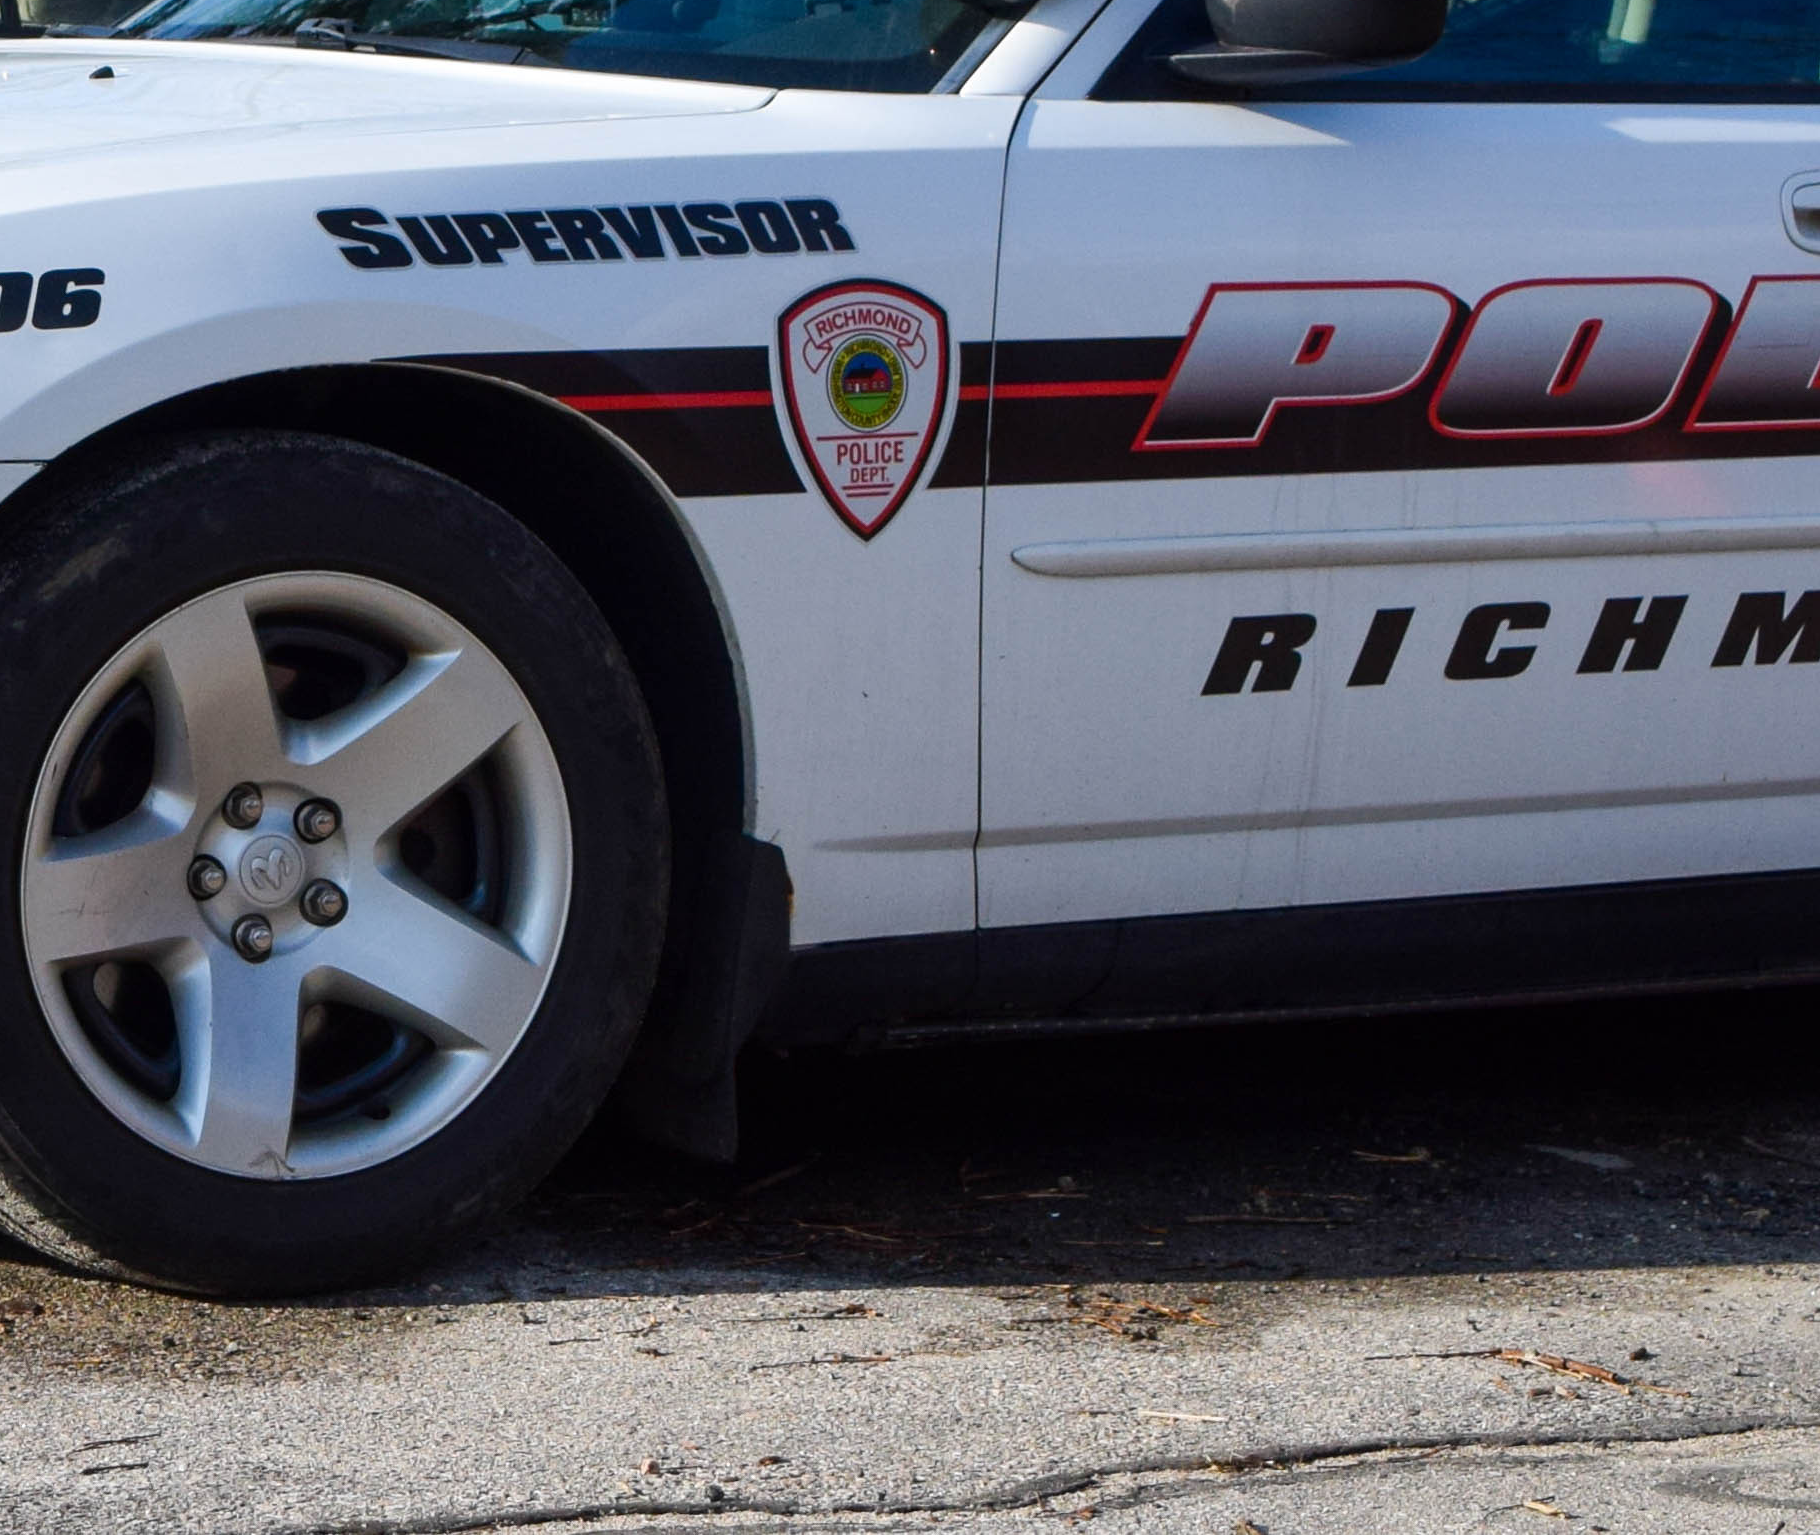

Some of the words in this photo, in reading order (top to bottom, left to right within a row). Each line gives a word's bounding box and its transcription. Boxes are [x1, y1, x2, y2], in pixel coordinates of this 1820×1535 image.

[317, 198, 855, 269] SUPERVISOR
[815, 309, 912, 338] RICHMOND
[837, 441, 905, 466] POLICE
[850, 466, 890, 484] DEPT.
